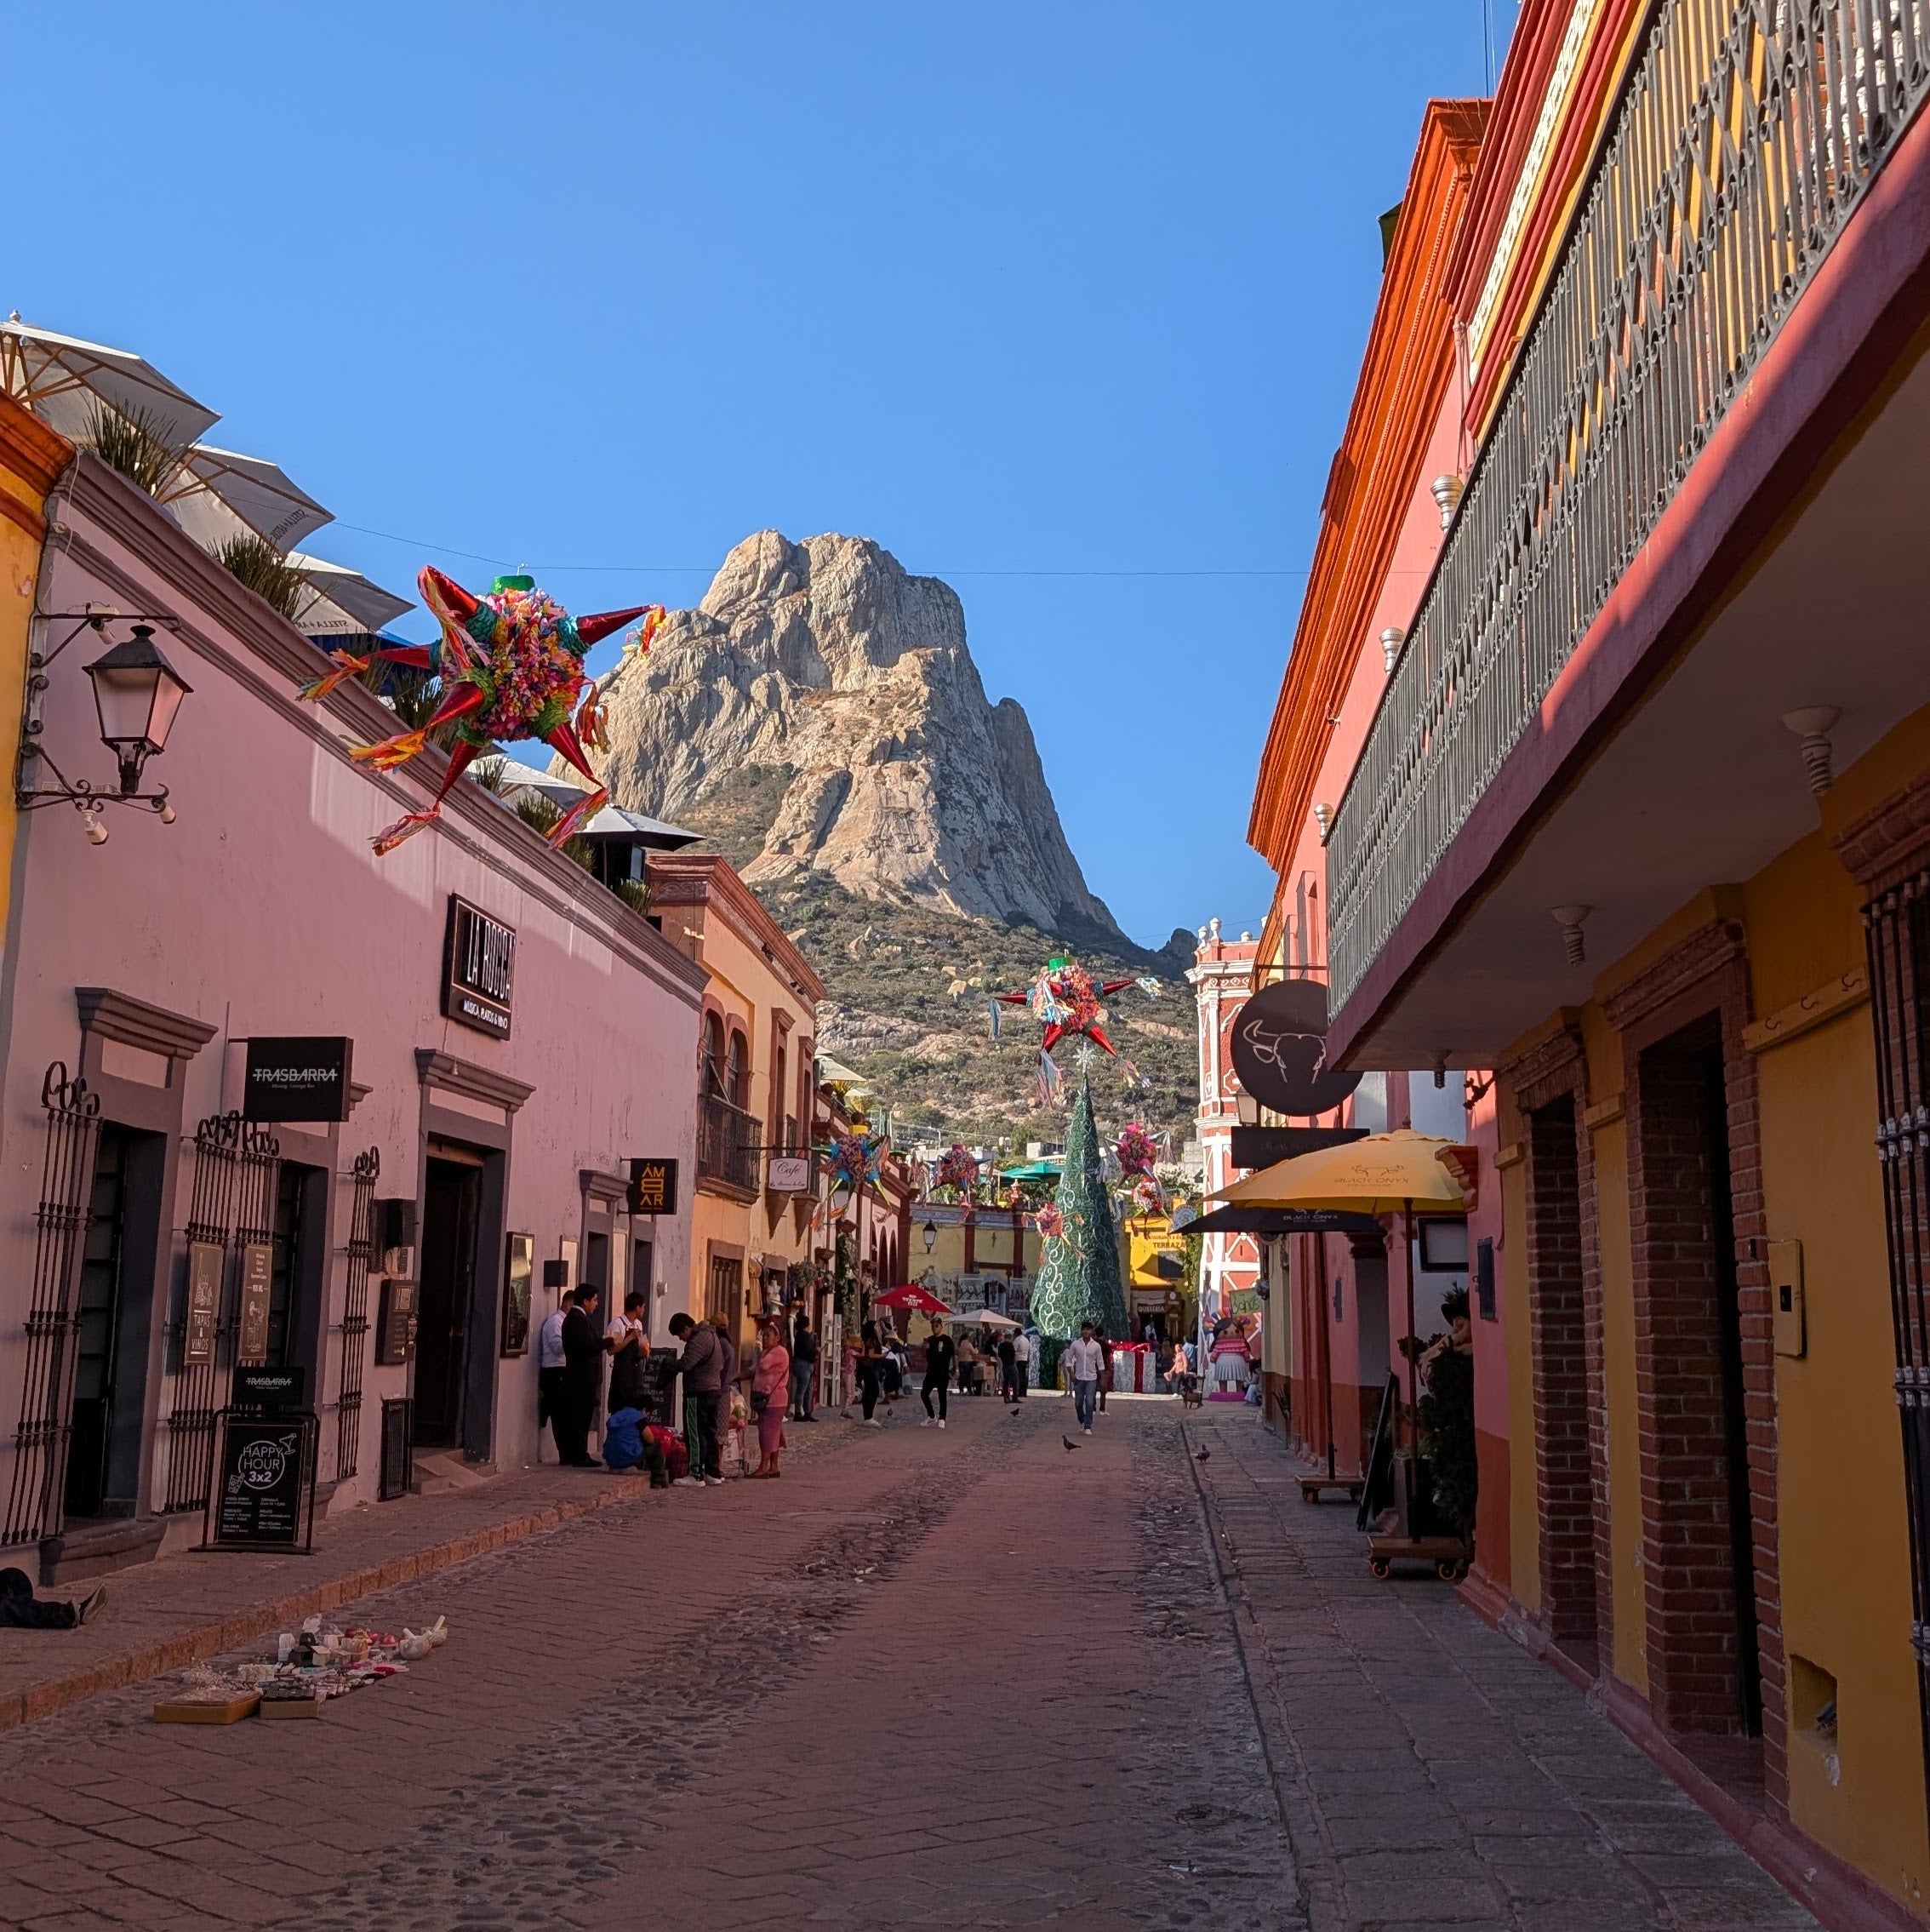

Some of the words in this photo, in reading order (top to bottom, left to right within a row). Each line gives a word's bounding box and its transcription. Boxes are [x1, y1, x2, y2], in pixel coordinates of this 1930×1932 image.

[466, 912, 479, 986] LA
[482, 921, 512, 1002] ROCCA
[253, 1068, 338, 1082] TRASBARRA
[775, 1160, 802, 1178] Café
[194, 1315, 210, 1327] TAPAS
[191, 1338, 208, 1351] VINOS
[243, 1446, 283, 1458] HAPPY
[243, 1458, 280, 1470] HOUR
[248, 1471, 272, 1483] 3x2
